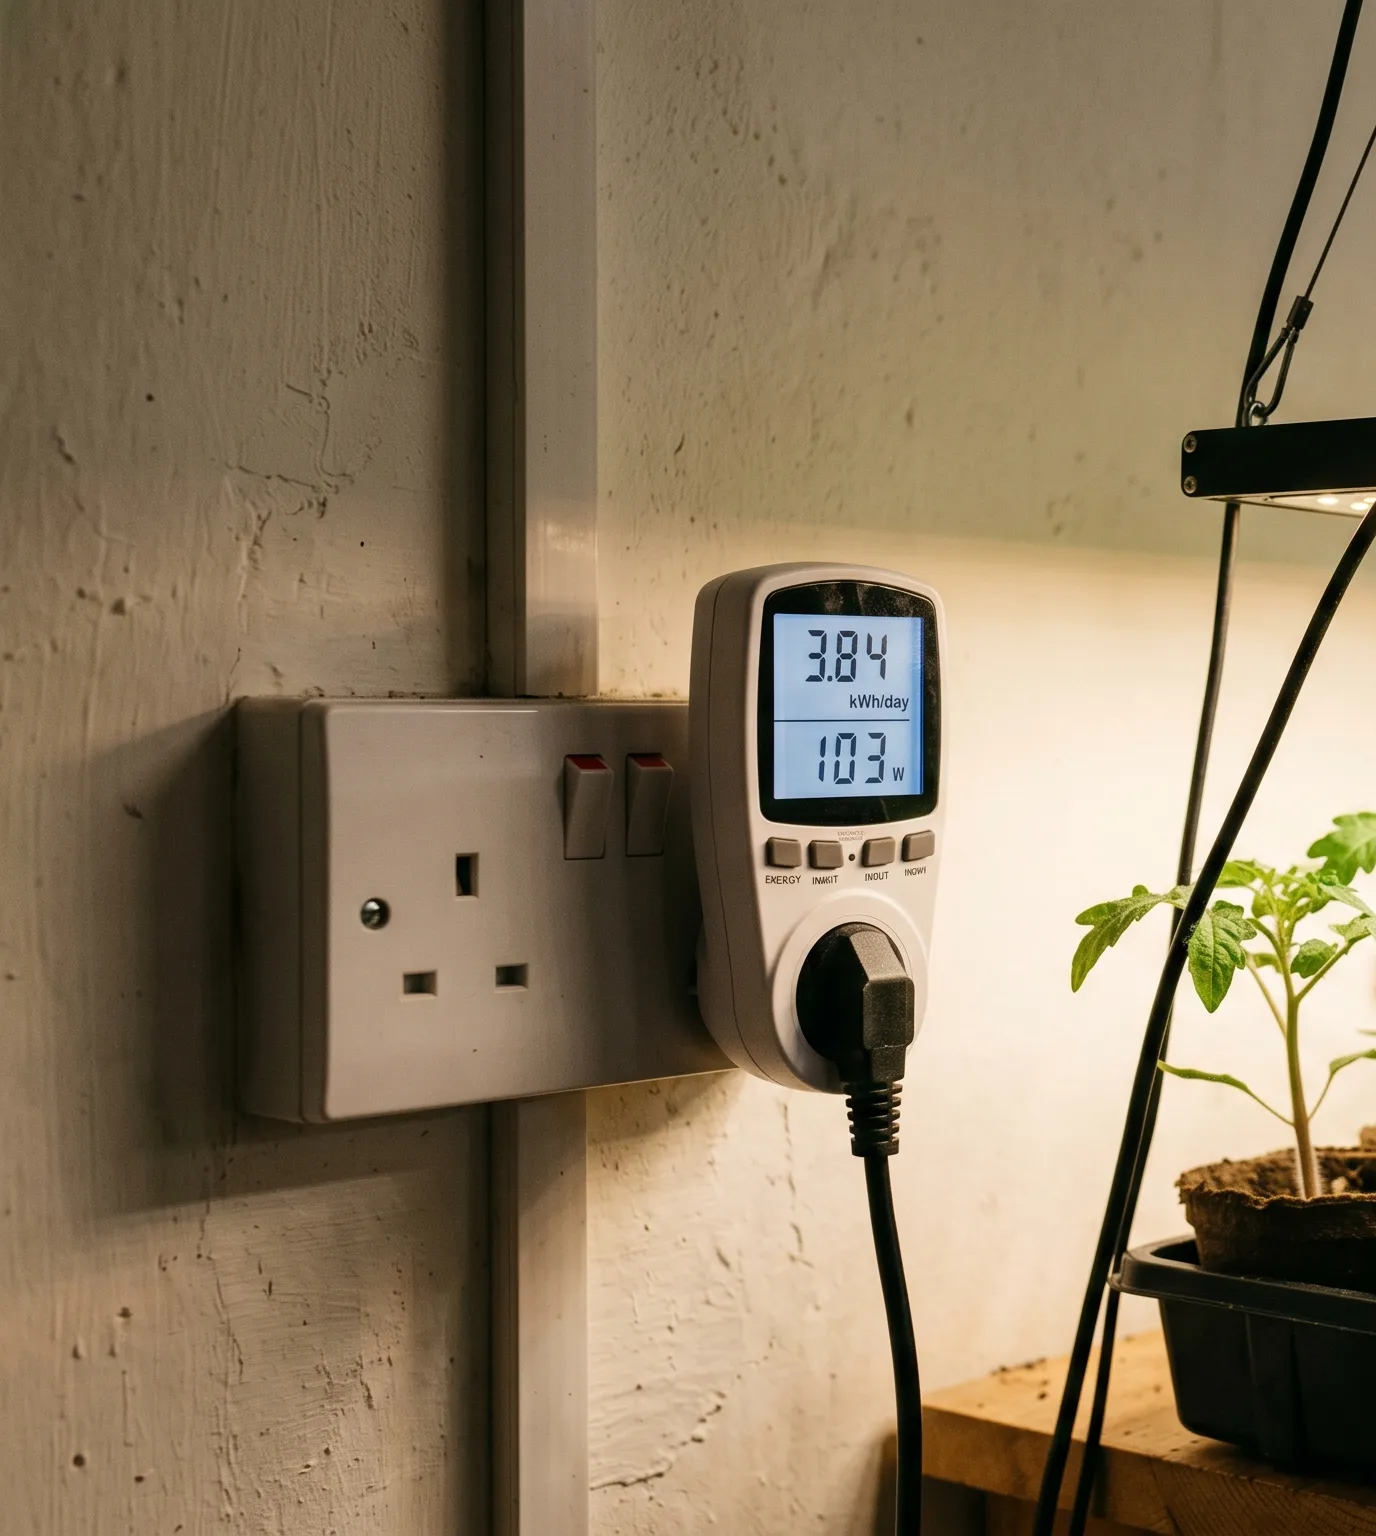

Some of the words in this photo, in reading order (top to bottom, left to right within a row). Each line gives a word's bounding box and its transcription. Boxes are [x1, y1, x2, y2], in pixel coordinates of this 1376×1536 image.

[805, 629, 888, 682] 3.84
[849, 694, 909, 712] kWh/day
[818, 732, 887, 785] 103
[892, 766, 905, 782] W
